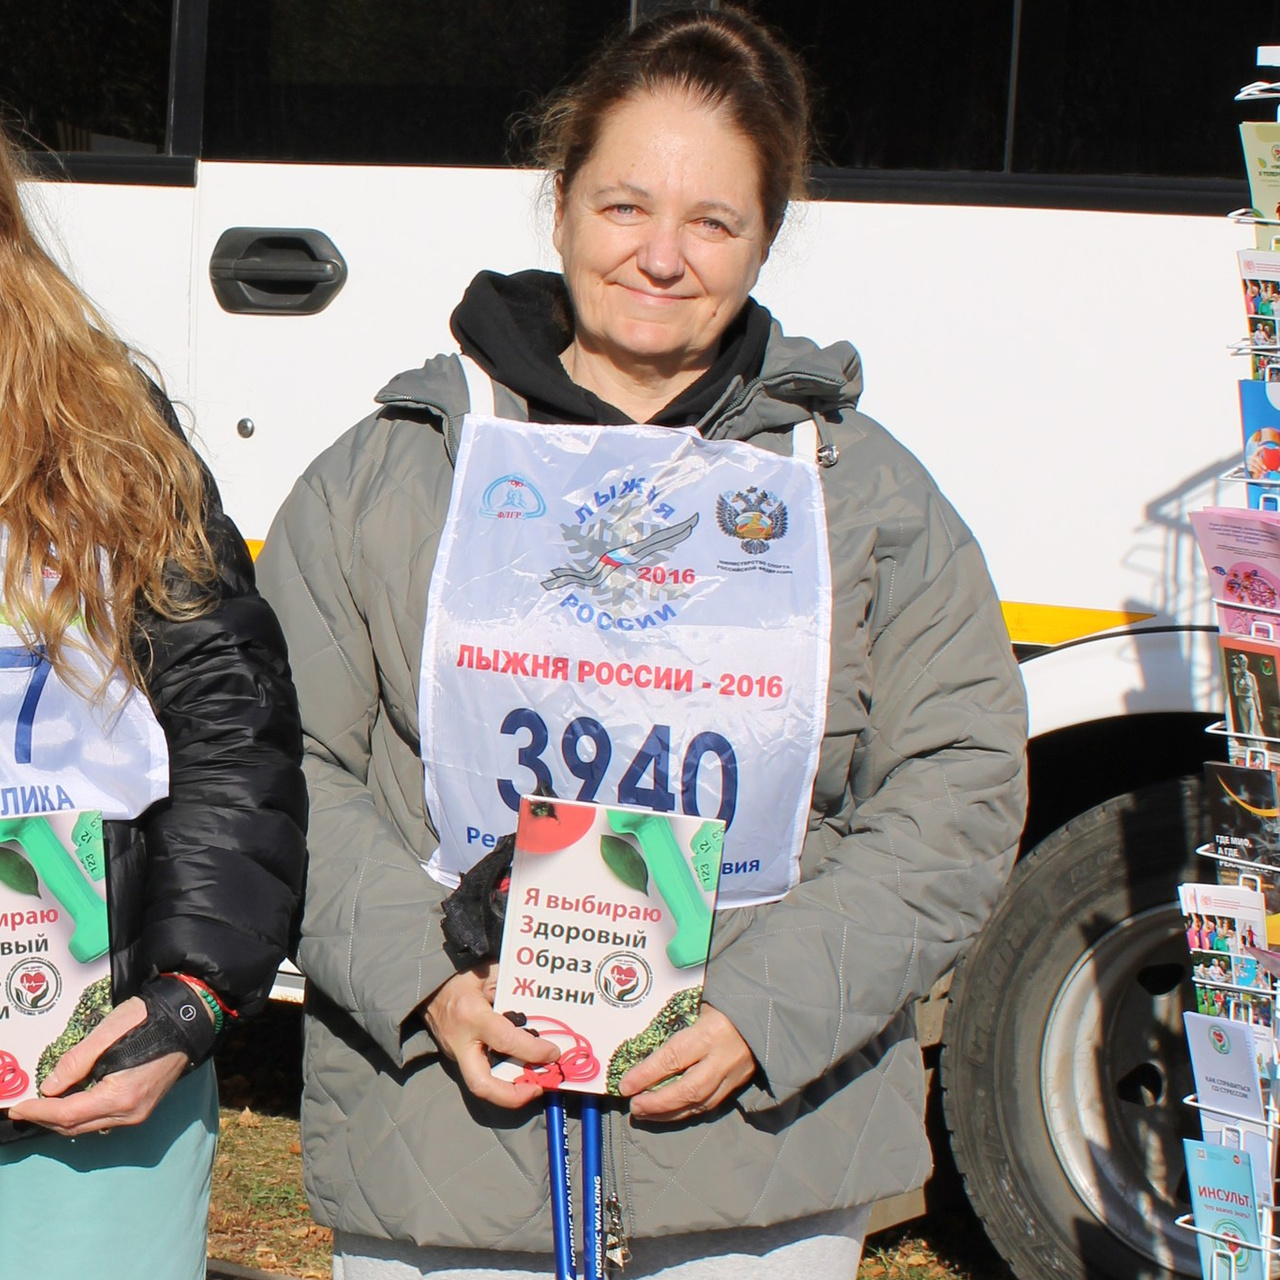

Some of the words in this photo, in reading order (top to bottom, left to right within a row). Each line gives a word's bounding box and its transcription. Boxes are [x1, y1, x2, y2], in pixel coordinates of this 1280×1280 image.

[637, 566, 695, 584] 2016
[559, 593, 677, 631] РОССИИ
[457, 644, 568, 681] ЛЫЖНЯ
[578, 661, 693, 692] РОССИИ
[719, 673, 783, 698] 2016
[496, 707, 738, 832] 3940
[524, 887, 540, 906] Я
[545, 893, 662, 923] выбираю
[520, 915, 647, 949] Здоровый
[516, 946, 592, 976] Образ
[512, 977, 595, 1006] Жизни
[594, 1175, 602, 1233] WALKING
[1198, 1185, 1253, 1208] ИНСУЛЬТ.
[595, 1233, 603, 1278] NORDIC
